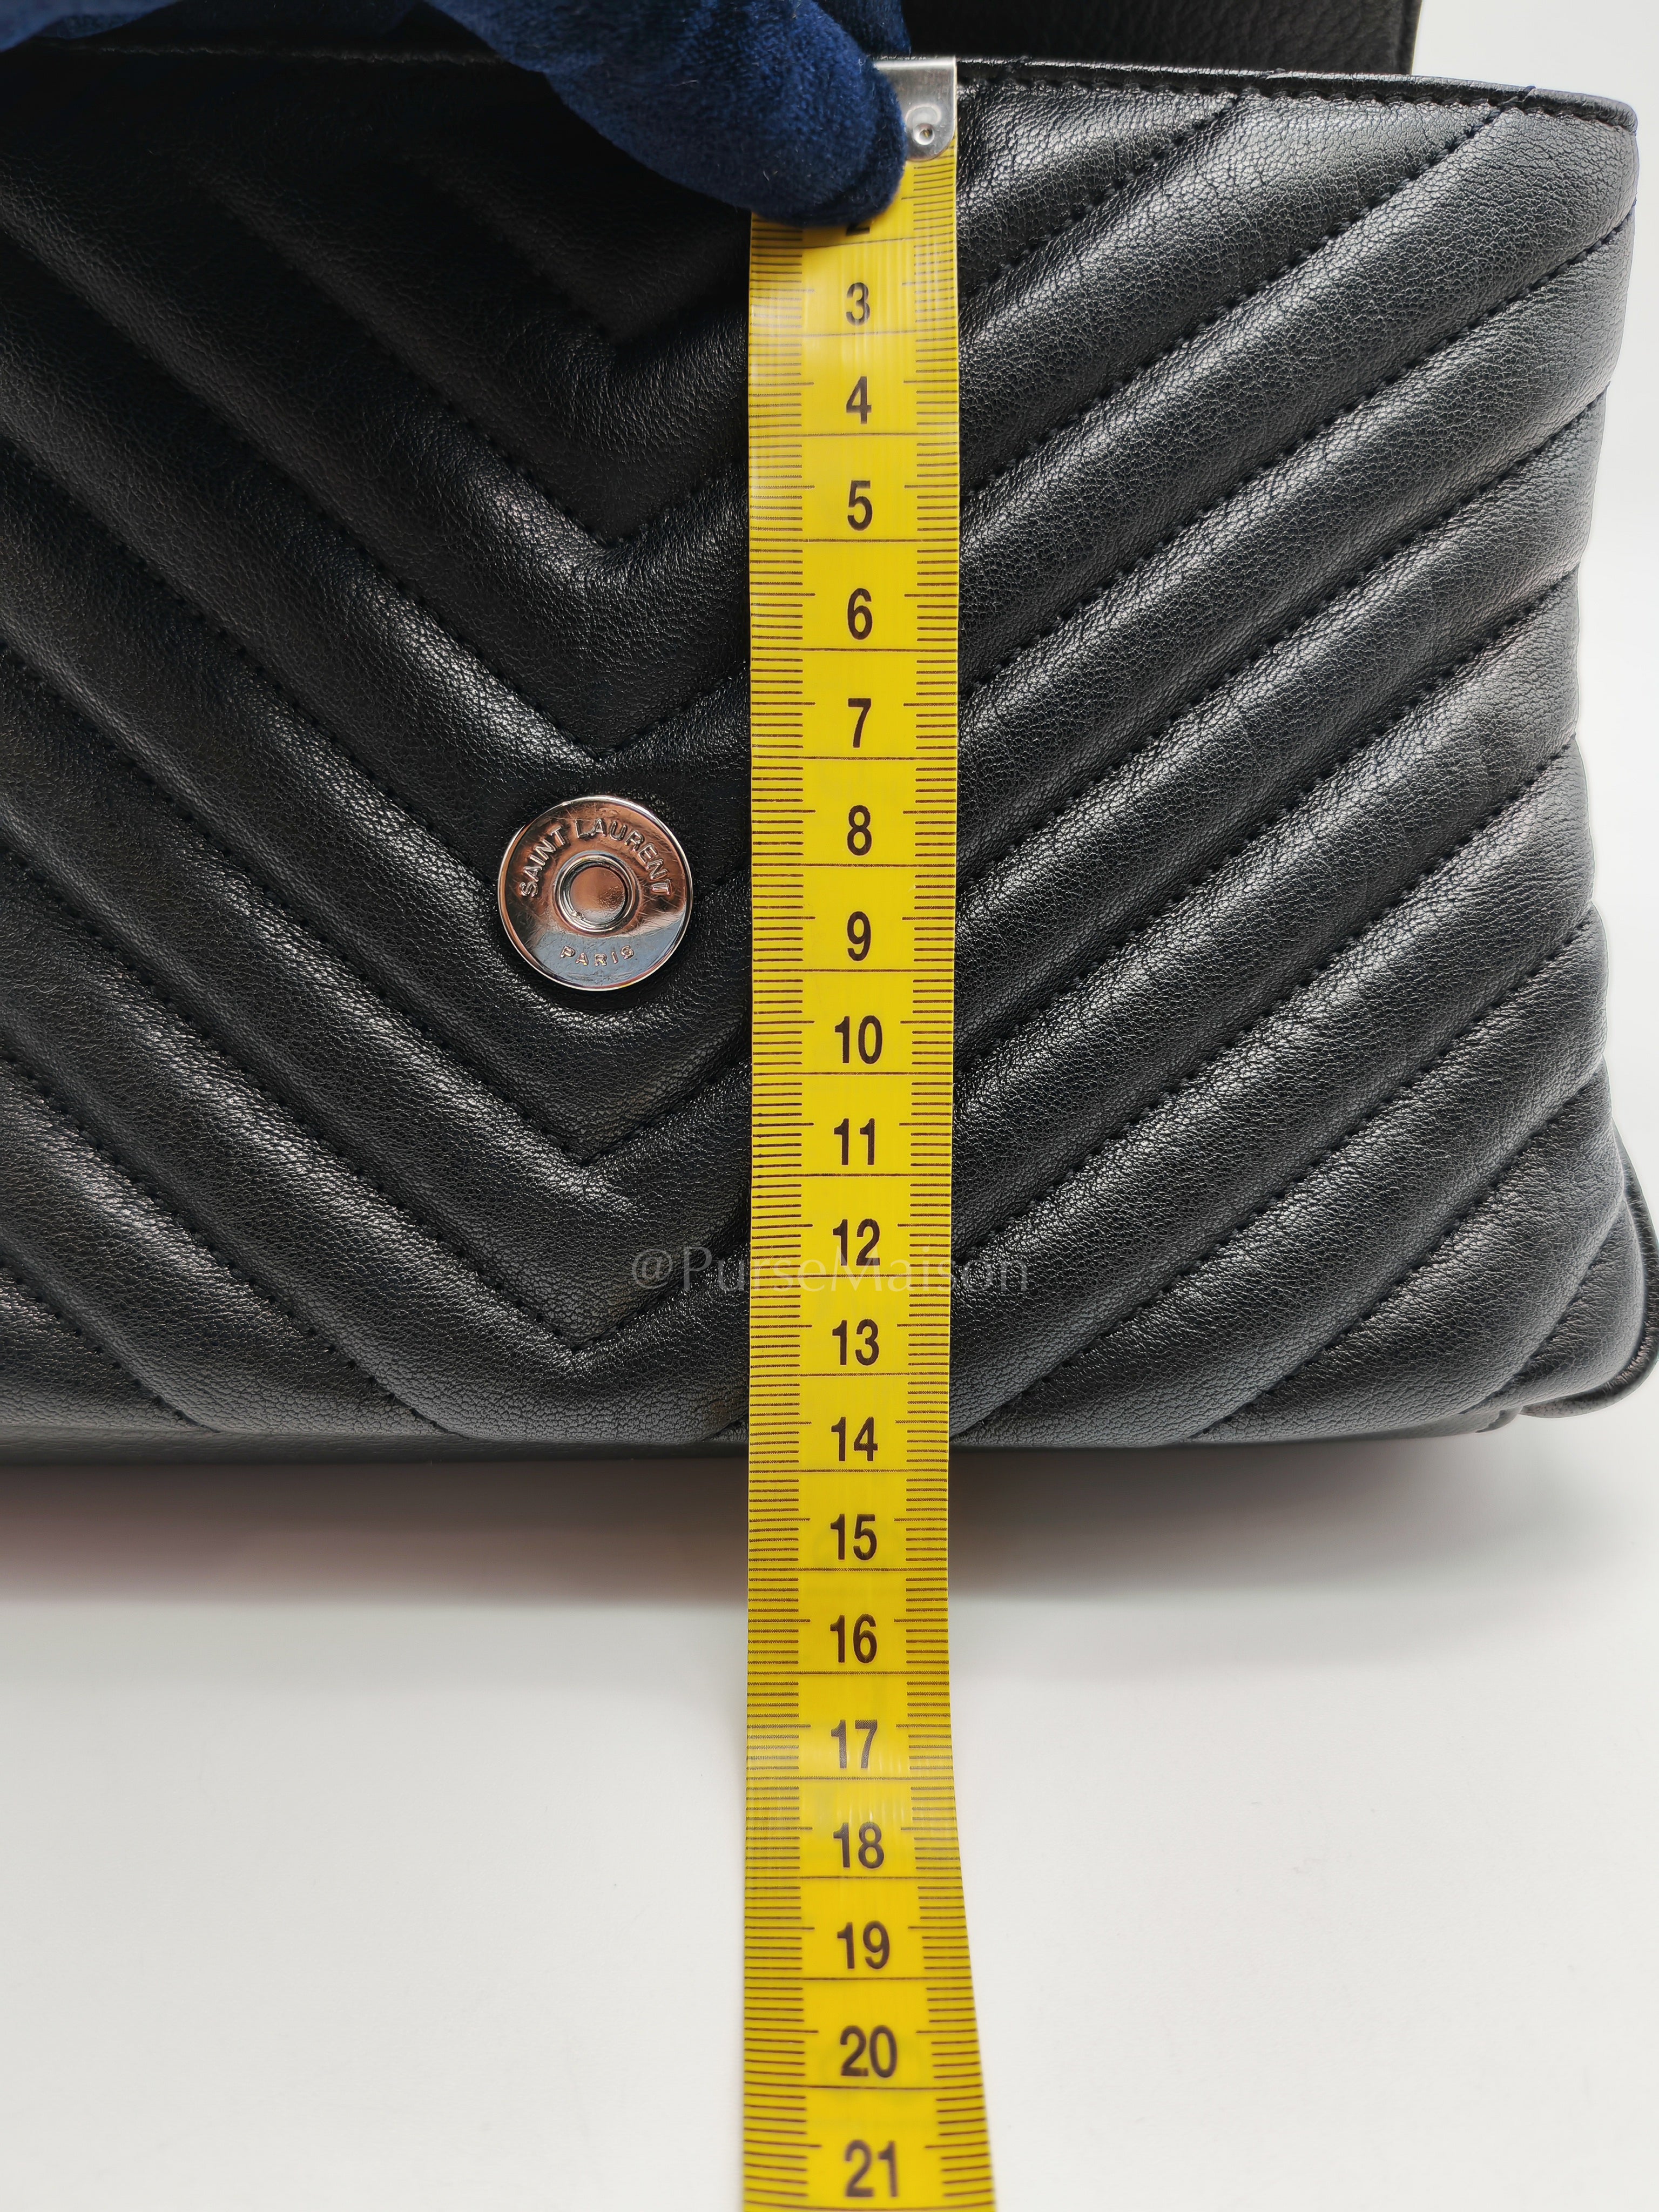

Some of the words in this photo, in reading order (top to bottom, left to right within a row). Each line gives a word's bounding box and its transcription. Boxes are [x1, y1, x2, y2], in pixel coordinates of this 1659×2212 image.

[846, 281, 871, 327] 3
[846, 377, 872, 422] 4
[847, 480, 873, 531] 5
[847, 587, 873, 640] 6
[847, 697, 872, 748] 7
[846, 804, 872, 857] 8
[518, 825, 567, 898] SAINT
[574, 818, 671, 896] LAURENT
[559, 945, 635, 967] PARIS
[846, 911, 872, 962] 9
[834, 1015, 883, 1065] 10
[833, 1117, 875, 1166] 11
[832, 1218, 880, 1266] 12
[832, 1318, 880, 1366] 13
[831, 1416, 879, 1462] 14
[830, 1513, 878, 1561] 15
[830, 1614, 878, 1664] 16
[831, 1719, 878, 1769] 17
[833, 1822, 885, 1869] 18
[837, 1920, 890, 1970] 19
[840, 2025, 898, 2078] 20
[845, 2139, 899, 2198] 21
